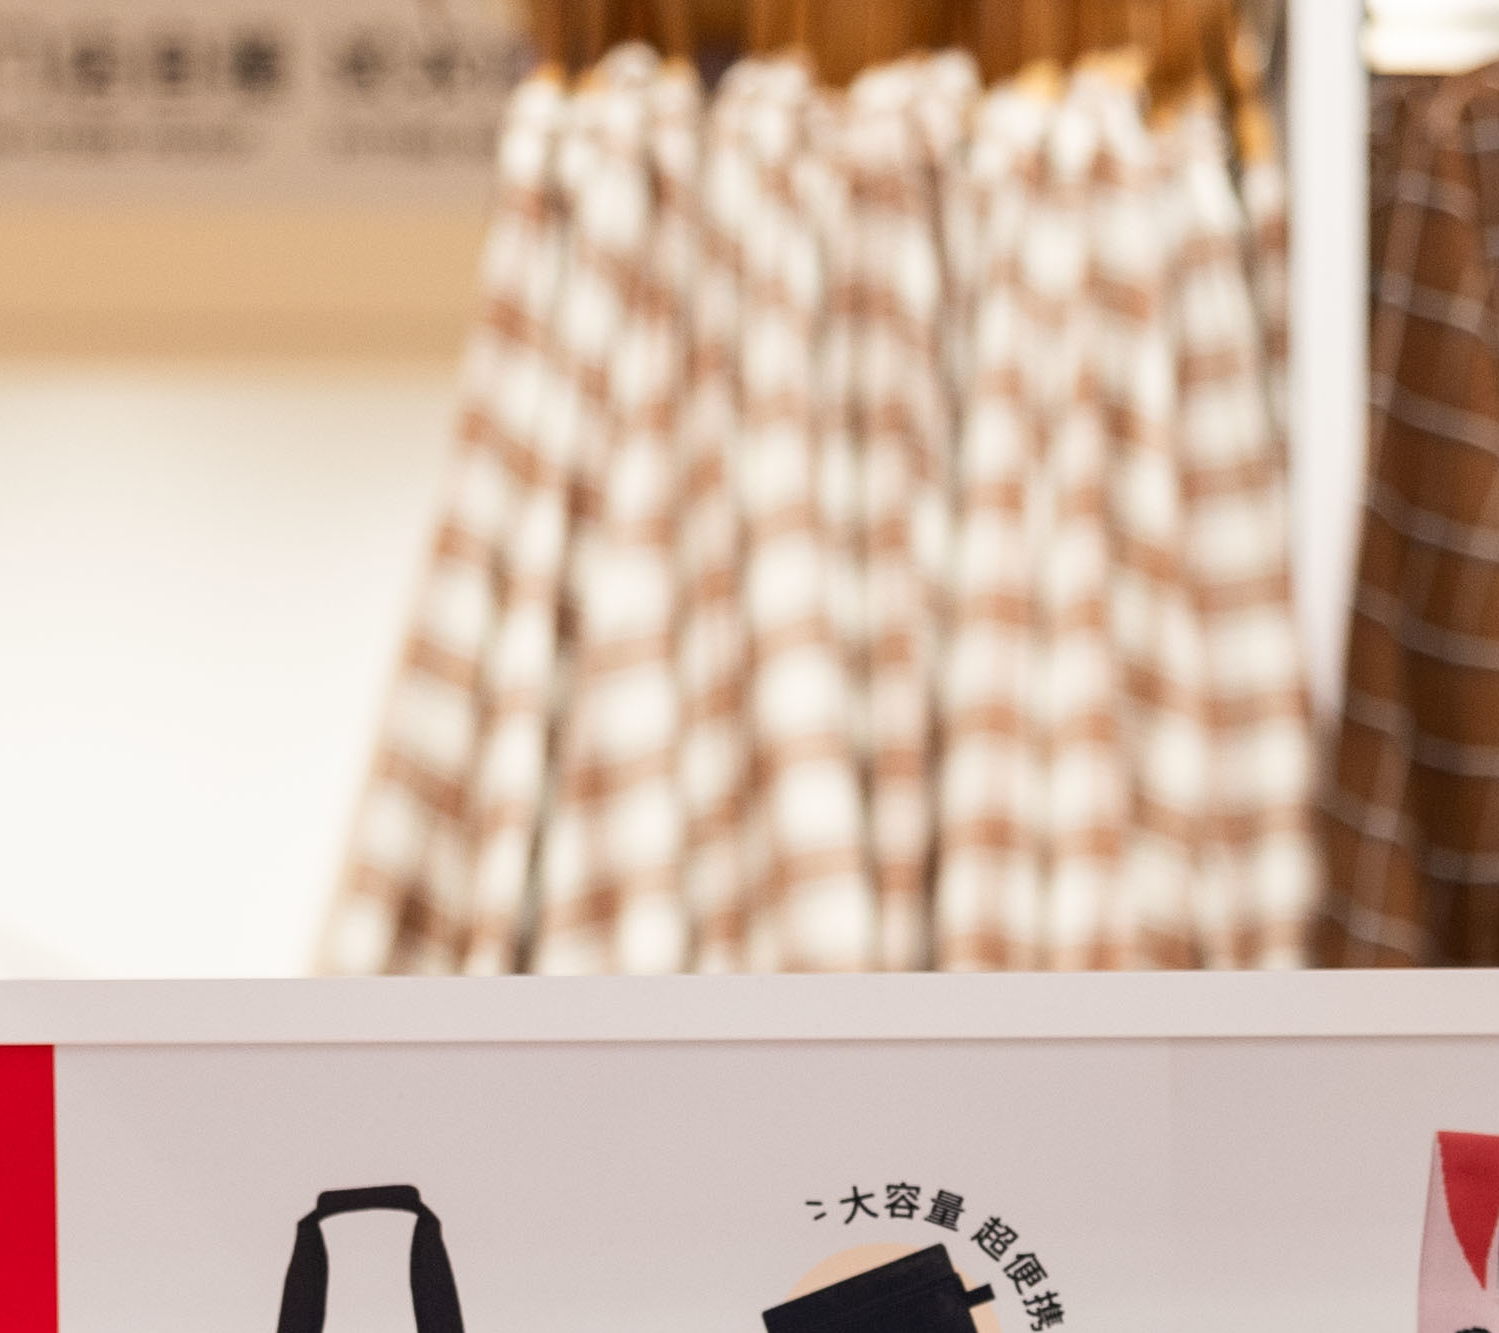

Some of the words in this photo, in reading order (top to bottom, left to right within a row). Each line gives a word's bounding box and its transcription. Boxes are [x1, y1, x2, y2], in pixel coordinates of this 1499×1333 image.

[839, 1182, 965, 1232] 大容量
[969, 1216, 1066, 1333] 超便携
